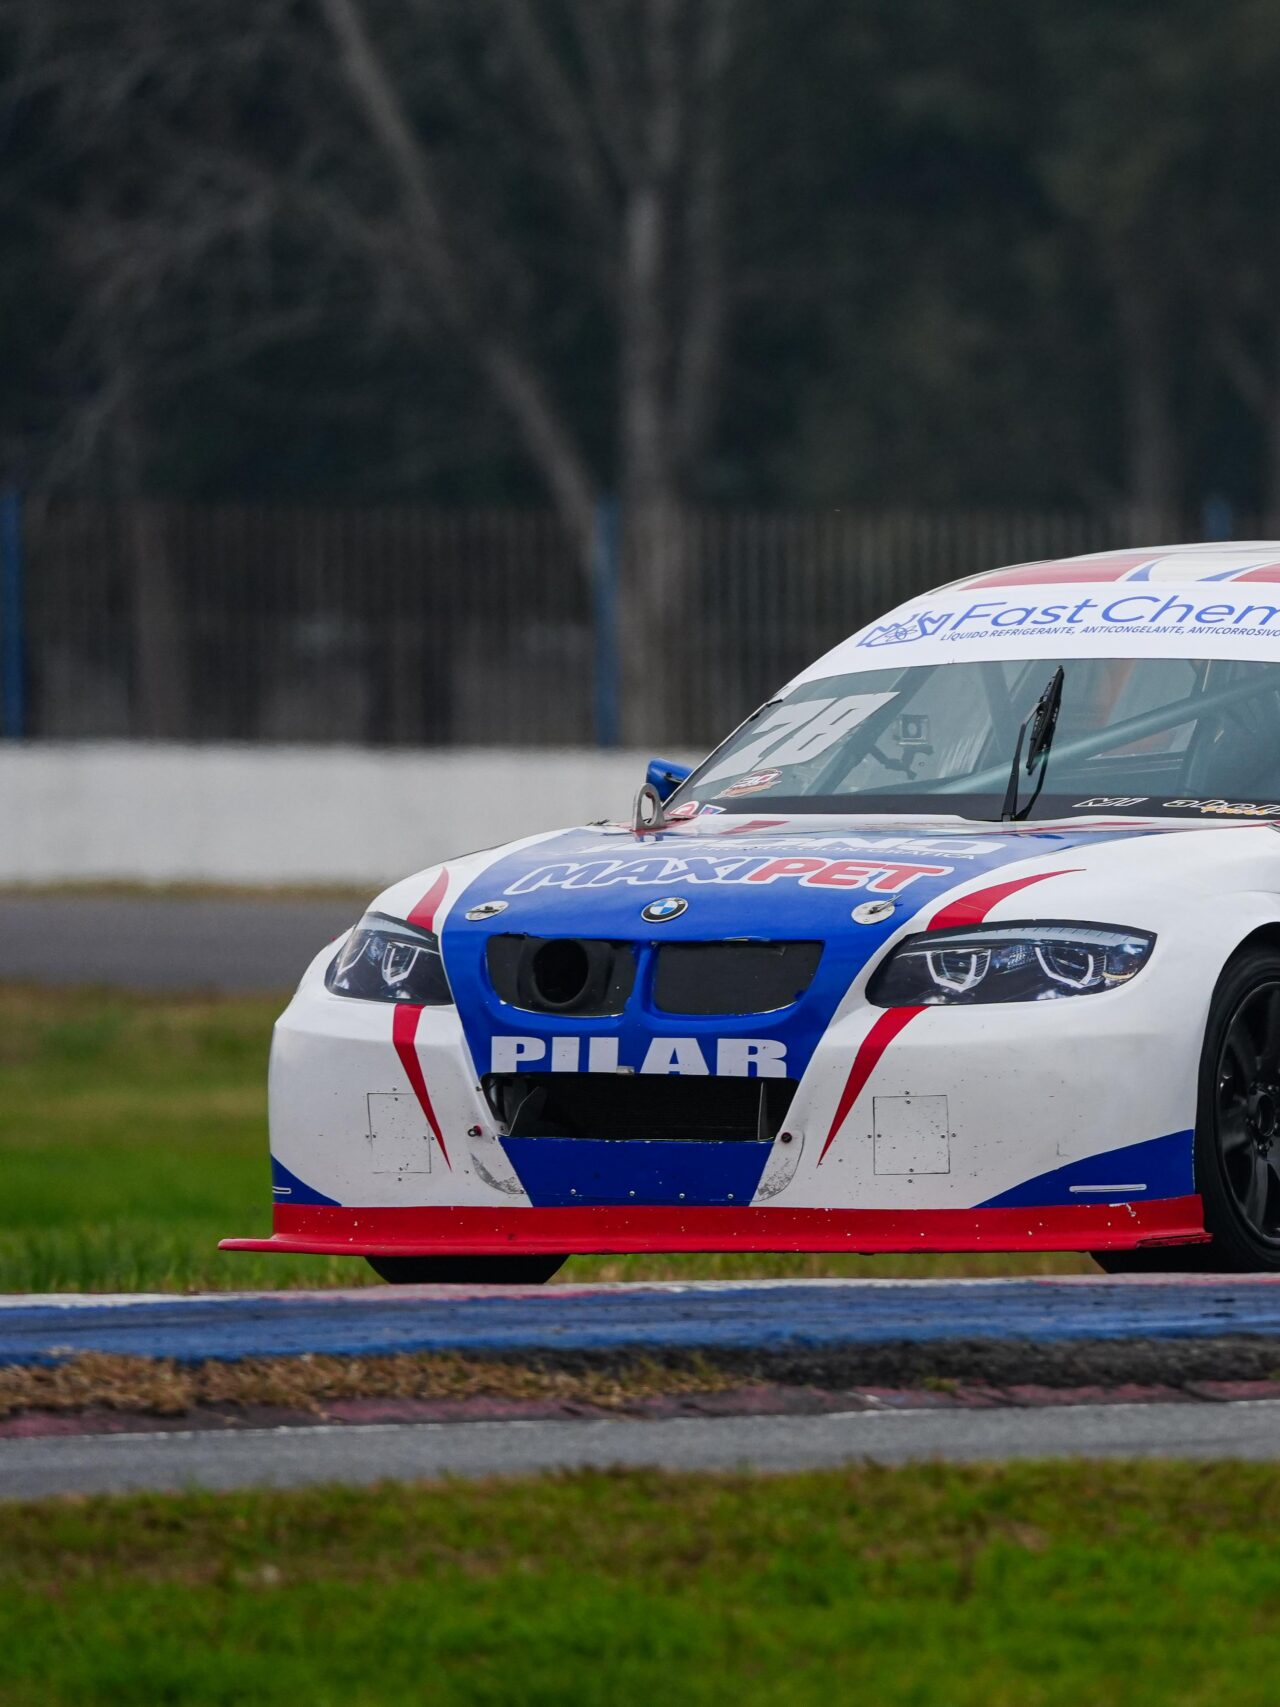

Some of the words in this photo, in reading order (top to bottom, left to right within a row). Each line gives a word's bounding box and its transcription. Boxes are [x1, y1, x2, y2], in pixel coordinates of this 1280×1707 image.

[940, 629, 989, 642] LÍQUIDO
[989, 626, 1076, 638] REFRIGERANTE,
[1079, 625, 1185, 635] ANTICONGELANTE,
[949, 598, 1098, 631] Fast
[693, 691, 900, 788] 78
[503, 856, 954, 896] MAXIPET
[490, 1036, 788, 1078] PILAR
